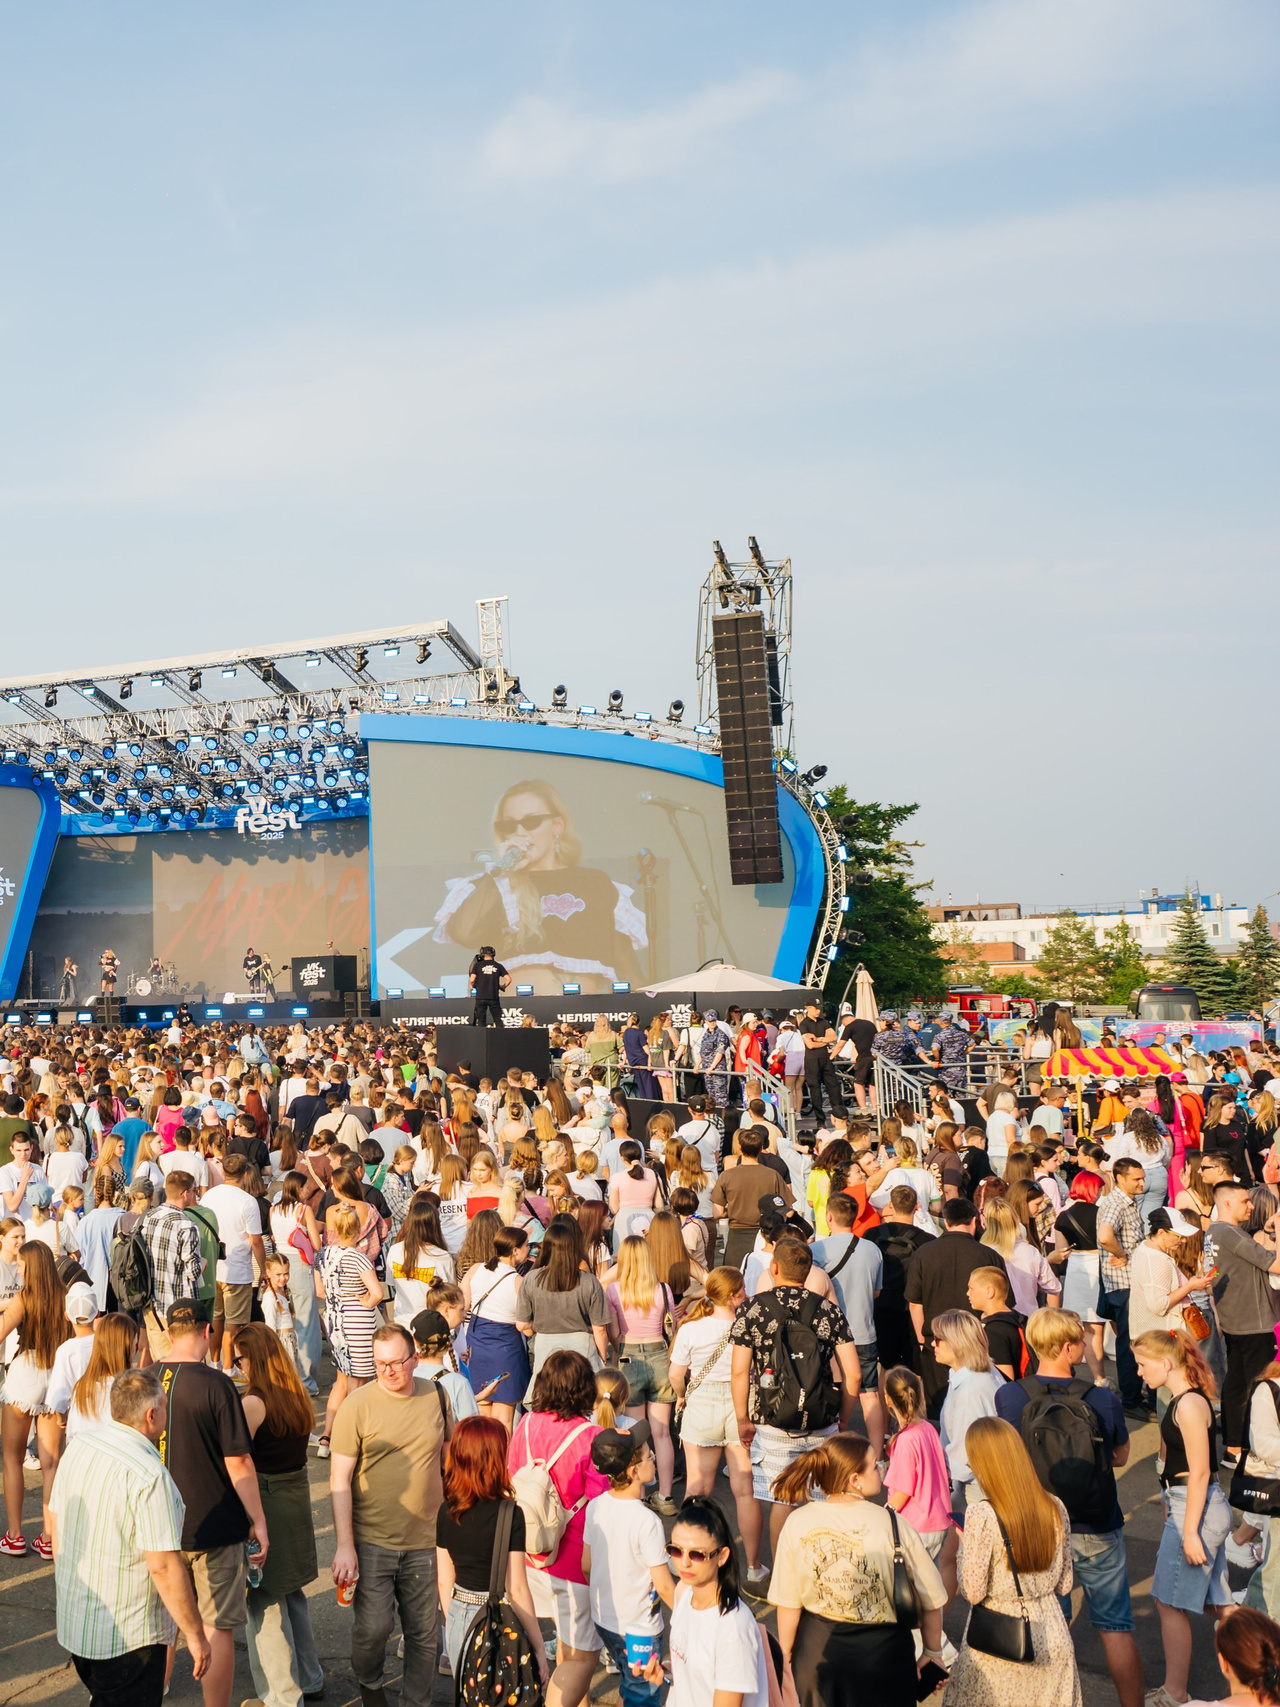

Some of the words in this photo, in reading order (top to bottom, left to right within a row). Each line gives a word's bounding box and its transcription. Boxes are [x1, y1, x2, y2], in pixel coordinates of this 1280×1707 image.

[235, 808, 302, 834] fest
[261, 831, 284, 840] 2025
[307, 962, 320, 970] VK
[299, 966, 326, 980] fest
[502, 1008, 524, 1017] VK
[671, 1004, 691, 1013] VK
[557, 1012, 636, 1022] ЧЕЛЯБИНС
[1162, 1022, 1198, 1033] fest
